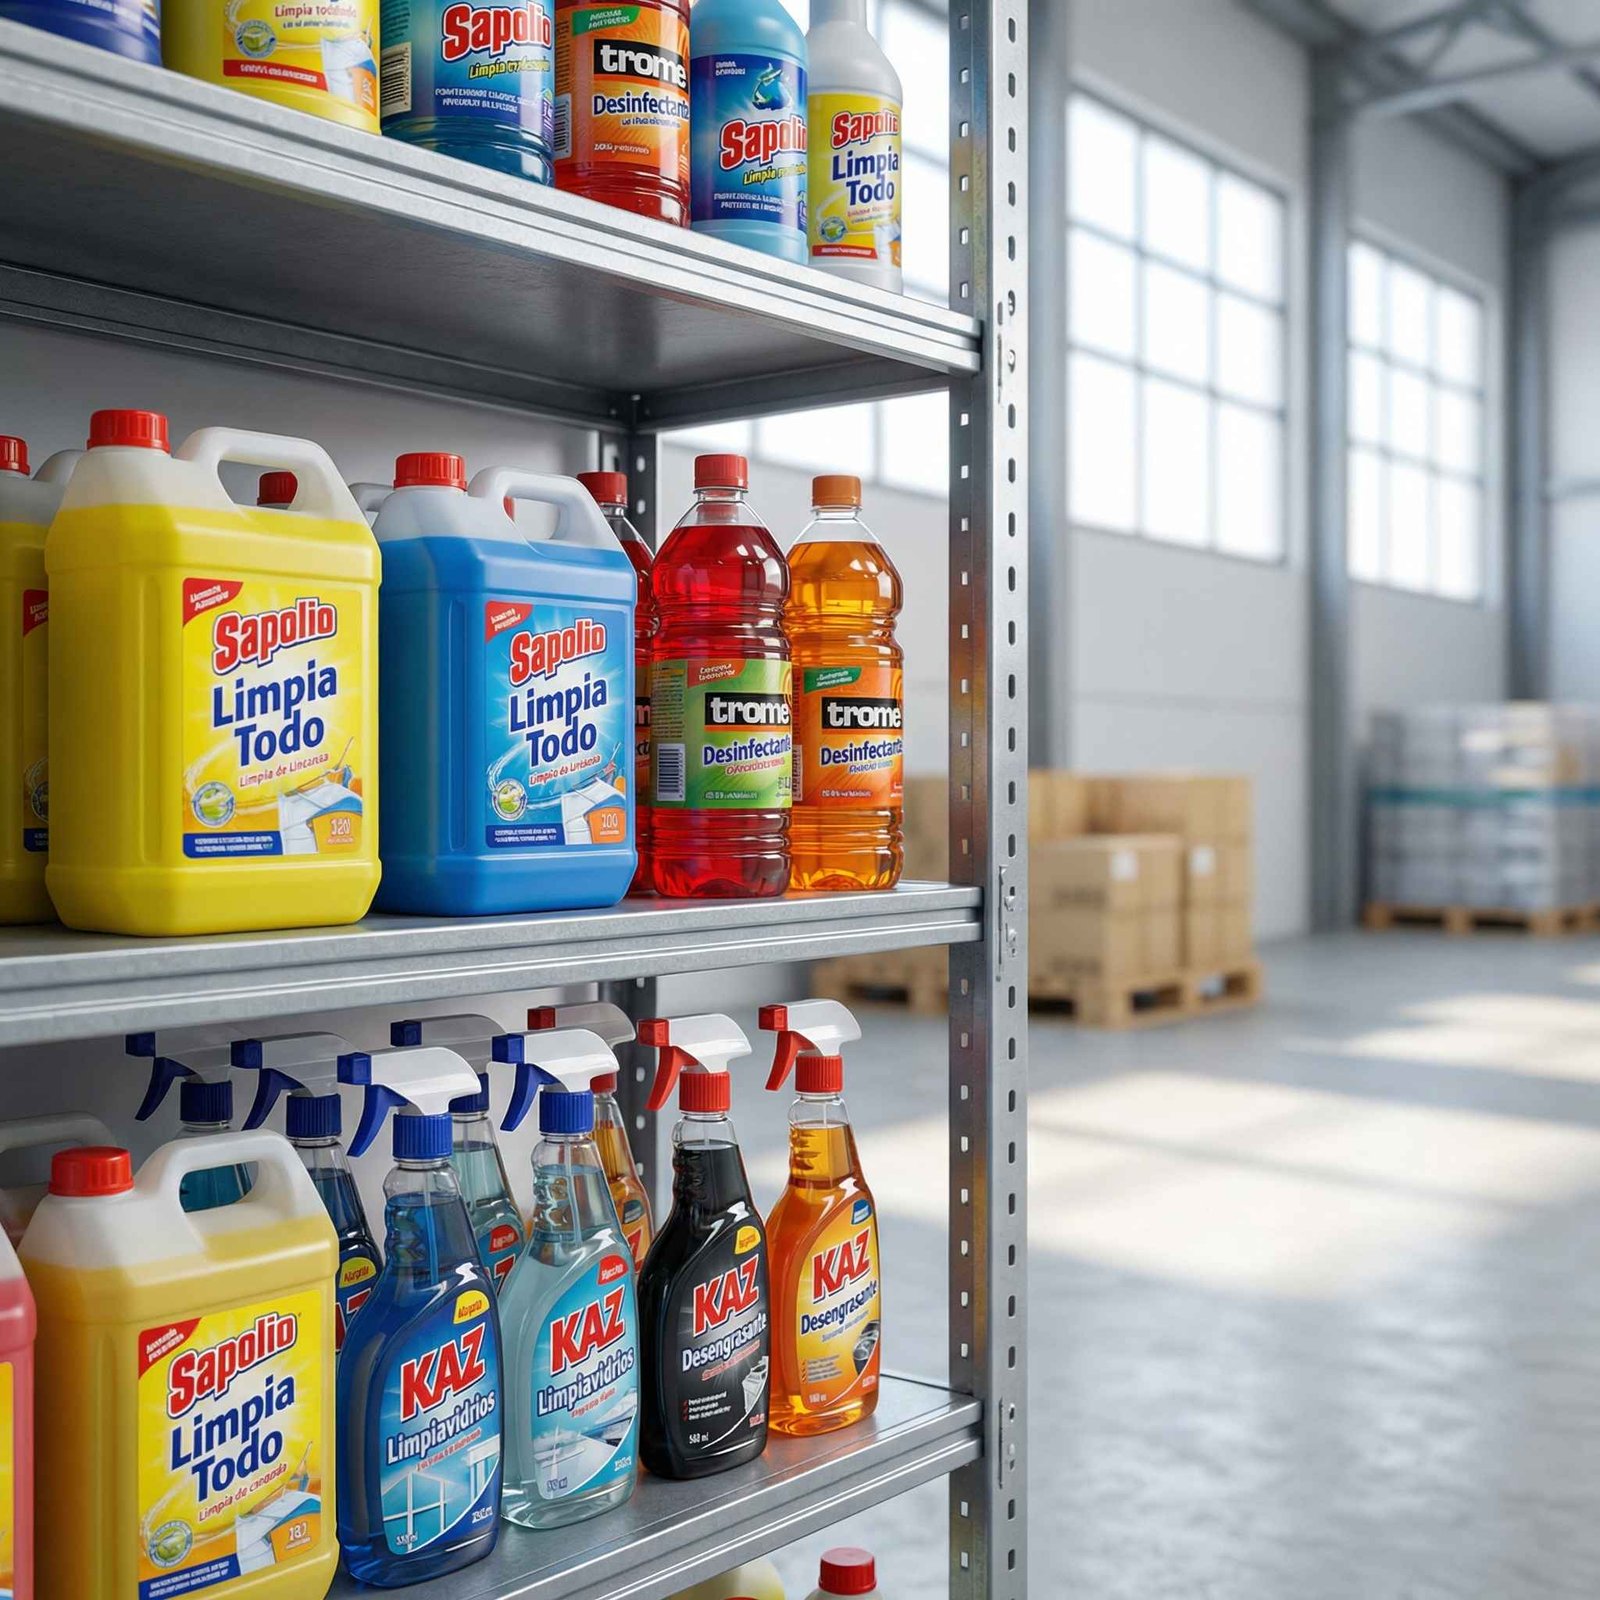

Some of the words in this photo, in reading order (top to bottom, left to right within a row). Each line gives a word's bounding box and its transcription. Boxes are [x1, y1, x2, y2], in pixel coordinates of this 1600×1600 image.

[442, 2, 552, 62] Sapolio
[600, 44, 687, 89] trome
[832, 146, 899, 180] Limpia
[846, 175, 895, 207] Todo
[212, 597, 338, 676] Sapolio
[509, 618, 608, 687] Sapolio
[213, 658, 337, 728] Limpia
[510, 672, 608, 732] Limpia
[711, 697, 790, 724] trome
[828, 702, 901, 728] trome
[234, 708, 325, 767] Todo
[526, 715, 598, 767] Todo
[240, 769, 273, 787] Limpia
[693, 1253, 760, 1338] KAZ
[812, 1229, 871, 1304] KAZ
[550, 1285, 626, 1376] KAZ
[167, 1312, 297, 1419] Sapolio
[400, 1323, 486, 1422] KAZ
[537, 1347, 635, 1417] Limpiavidrios
[171, 1374, 295, 1471] Limpia
[386, 1390, 496, 1465] Limpiavidrios
[191, 1427, 283, 1502] Todo
[199, 1495, 233, 1522] Limpia
